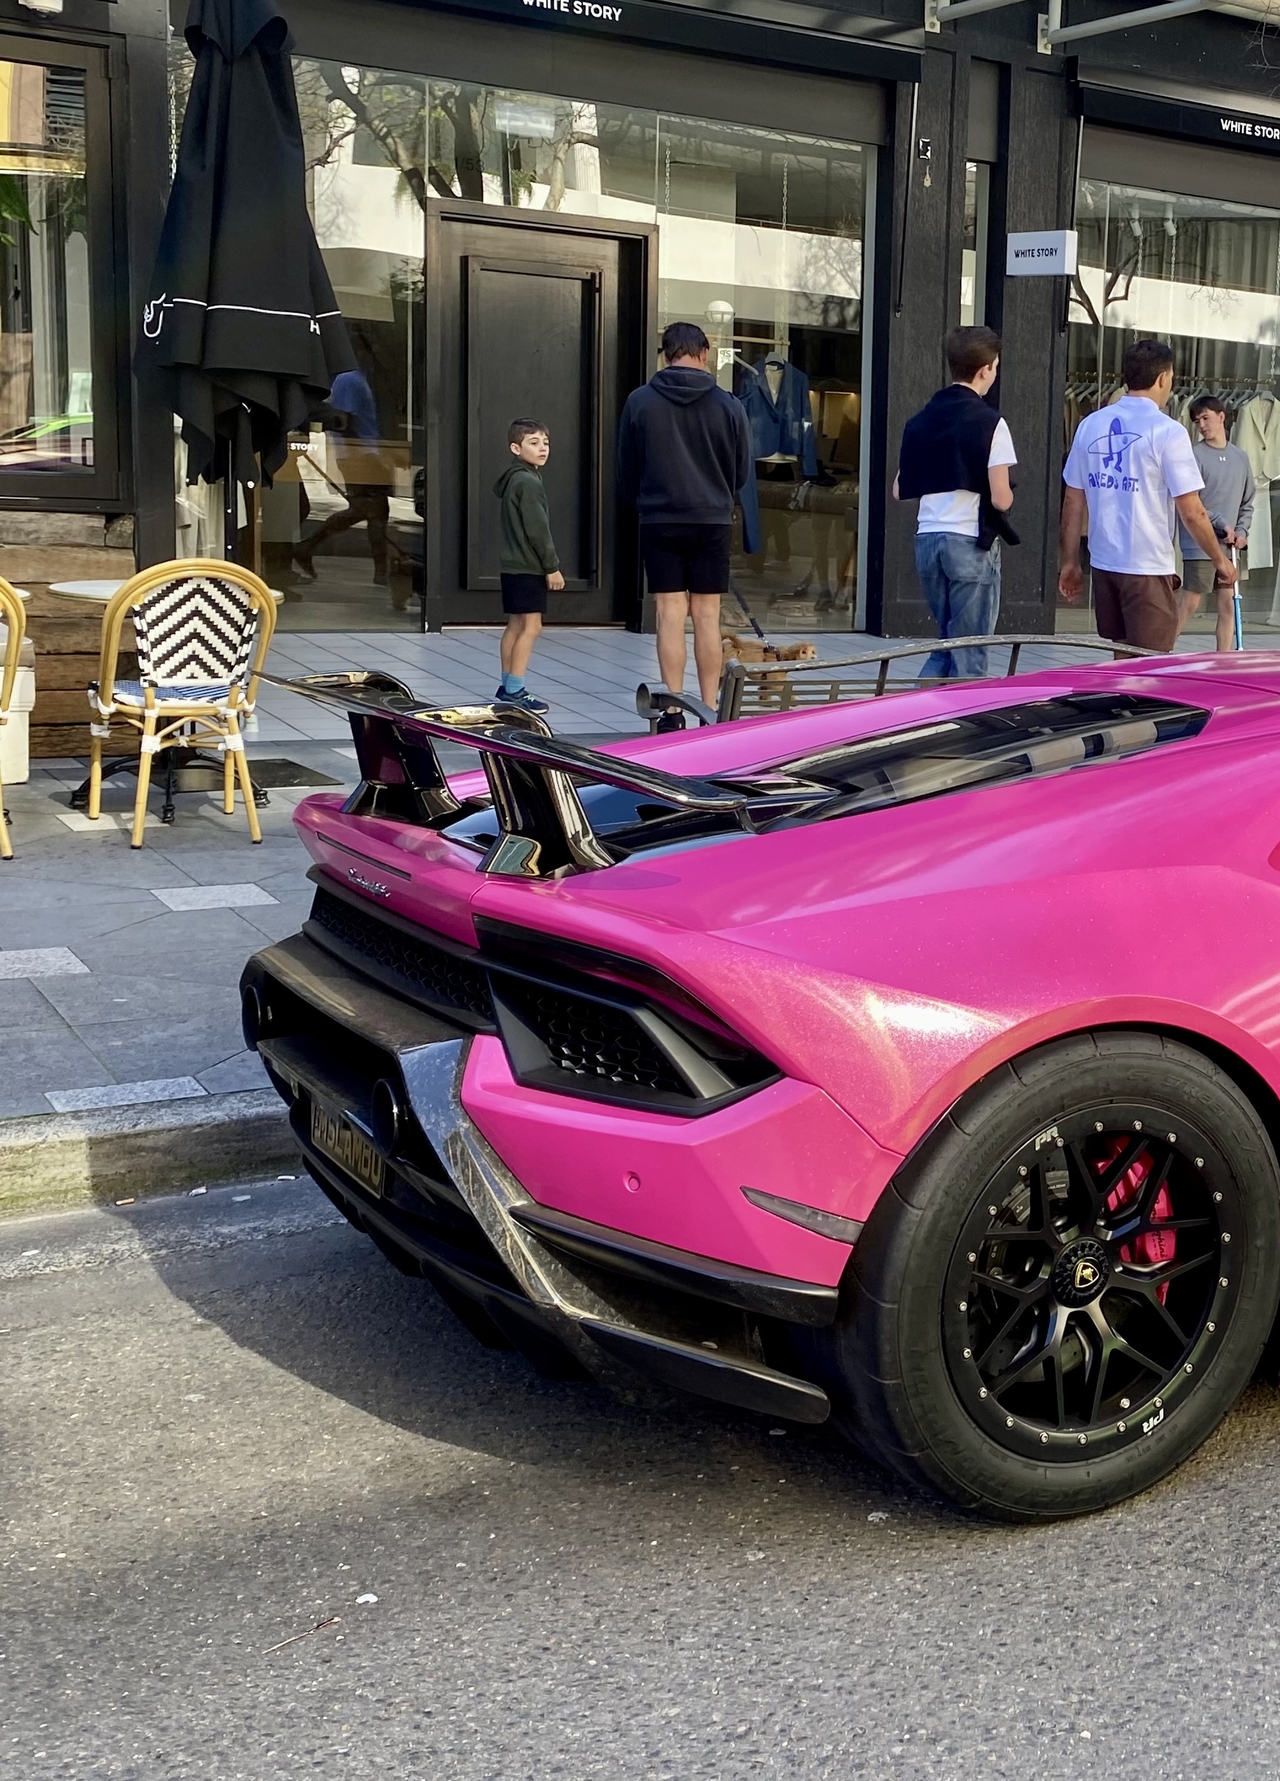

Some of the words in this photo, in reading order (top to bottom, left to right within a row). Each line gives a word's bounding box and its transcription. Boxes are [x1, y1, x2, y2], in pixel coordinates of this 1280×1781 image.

[573, 1, 622, 21] STORY
[1220, 118, 1252, 136] WHITE
[1014, 248, 1036, 258] WHITE
[1036, 247, 1059, 258] STORY
[290, 442, 319, 451] STORY
